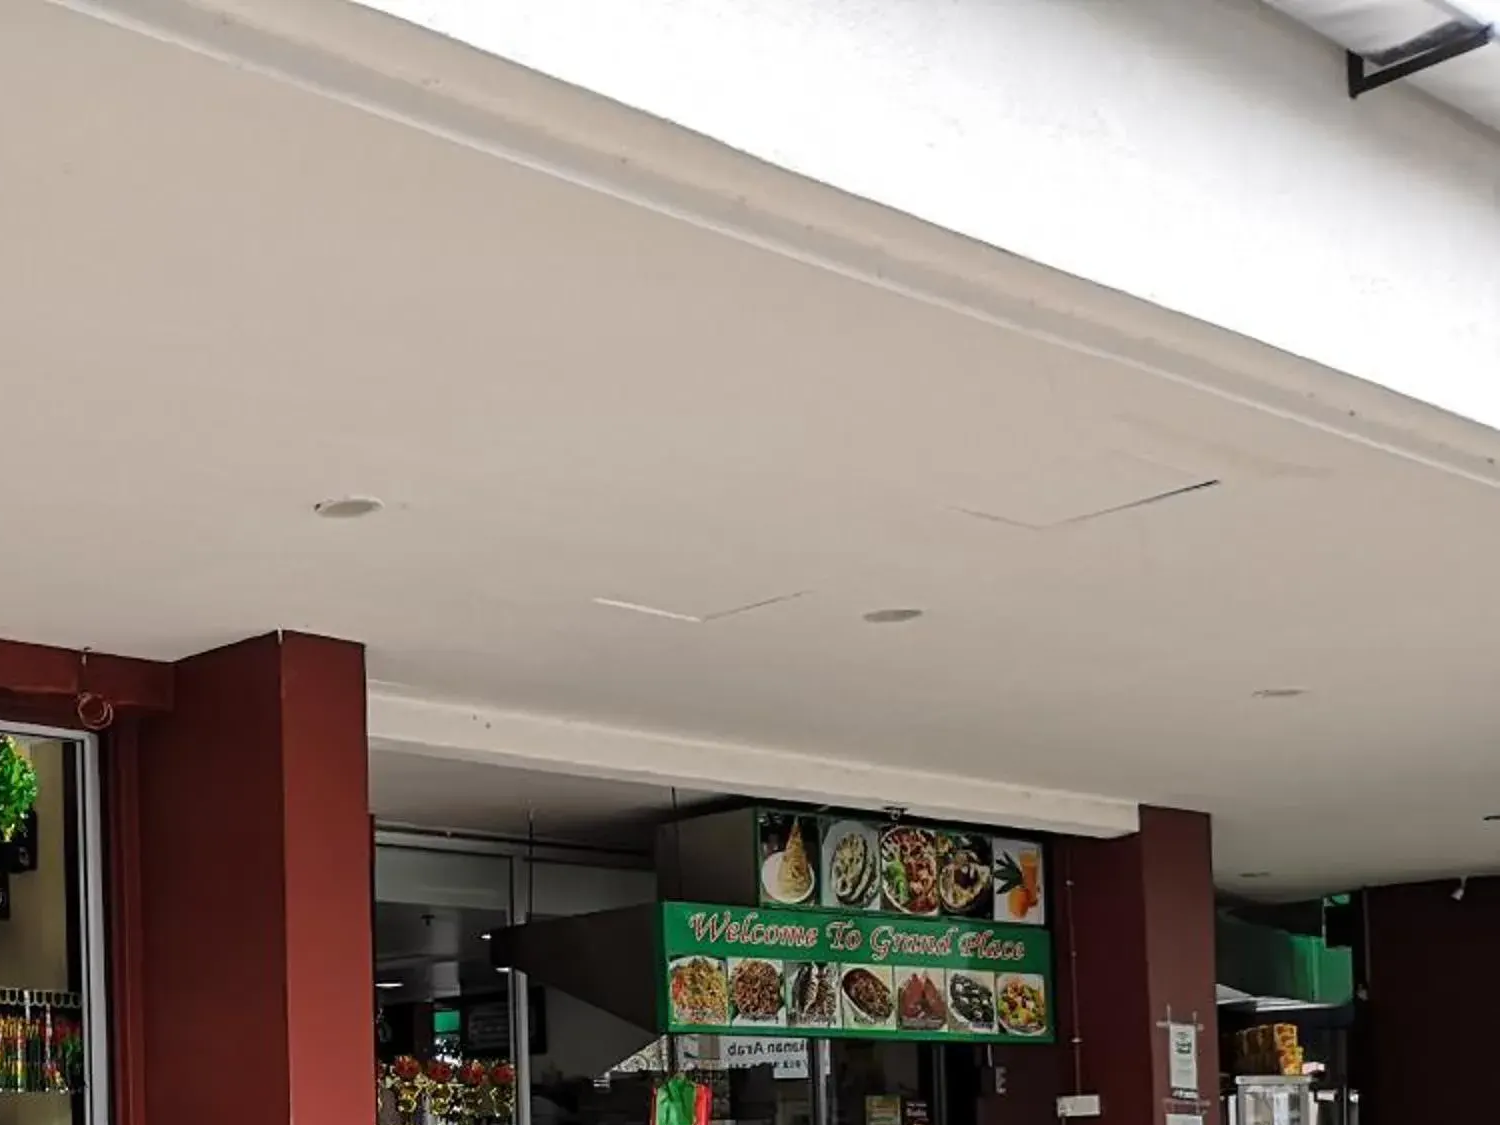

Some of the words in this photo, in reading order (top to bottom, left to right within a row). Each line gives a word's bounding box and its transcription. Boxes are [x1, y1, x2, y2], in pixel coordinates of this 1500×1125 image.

[689, 911, 819, 948] Welcome
[825, 920, 862, 951] To
[869, 924, 958, 960] Grand
[956, 929, 1026, 961] Place
